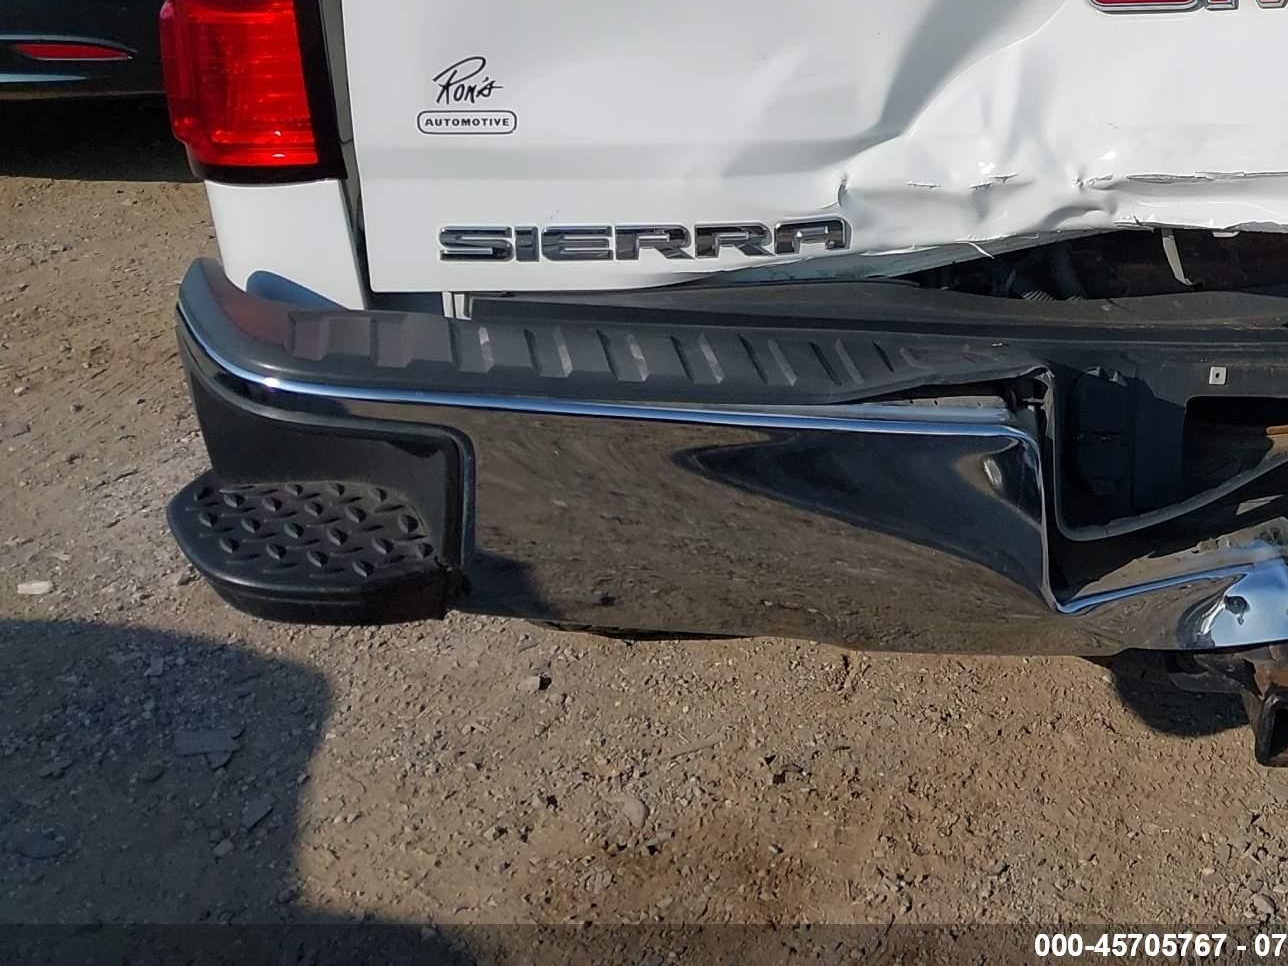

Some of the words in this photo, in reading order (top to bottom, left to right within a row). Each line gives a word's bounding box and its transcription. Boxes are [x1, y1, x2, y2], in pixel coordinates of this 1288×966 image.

[432, 56, 504, 105] Ron's
[424, 118, 510, 127] AUTOMOTIVE
[438, 216, 851, 263] SIERRA
